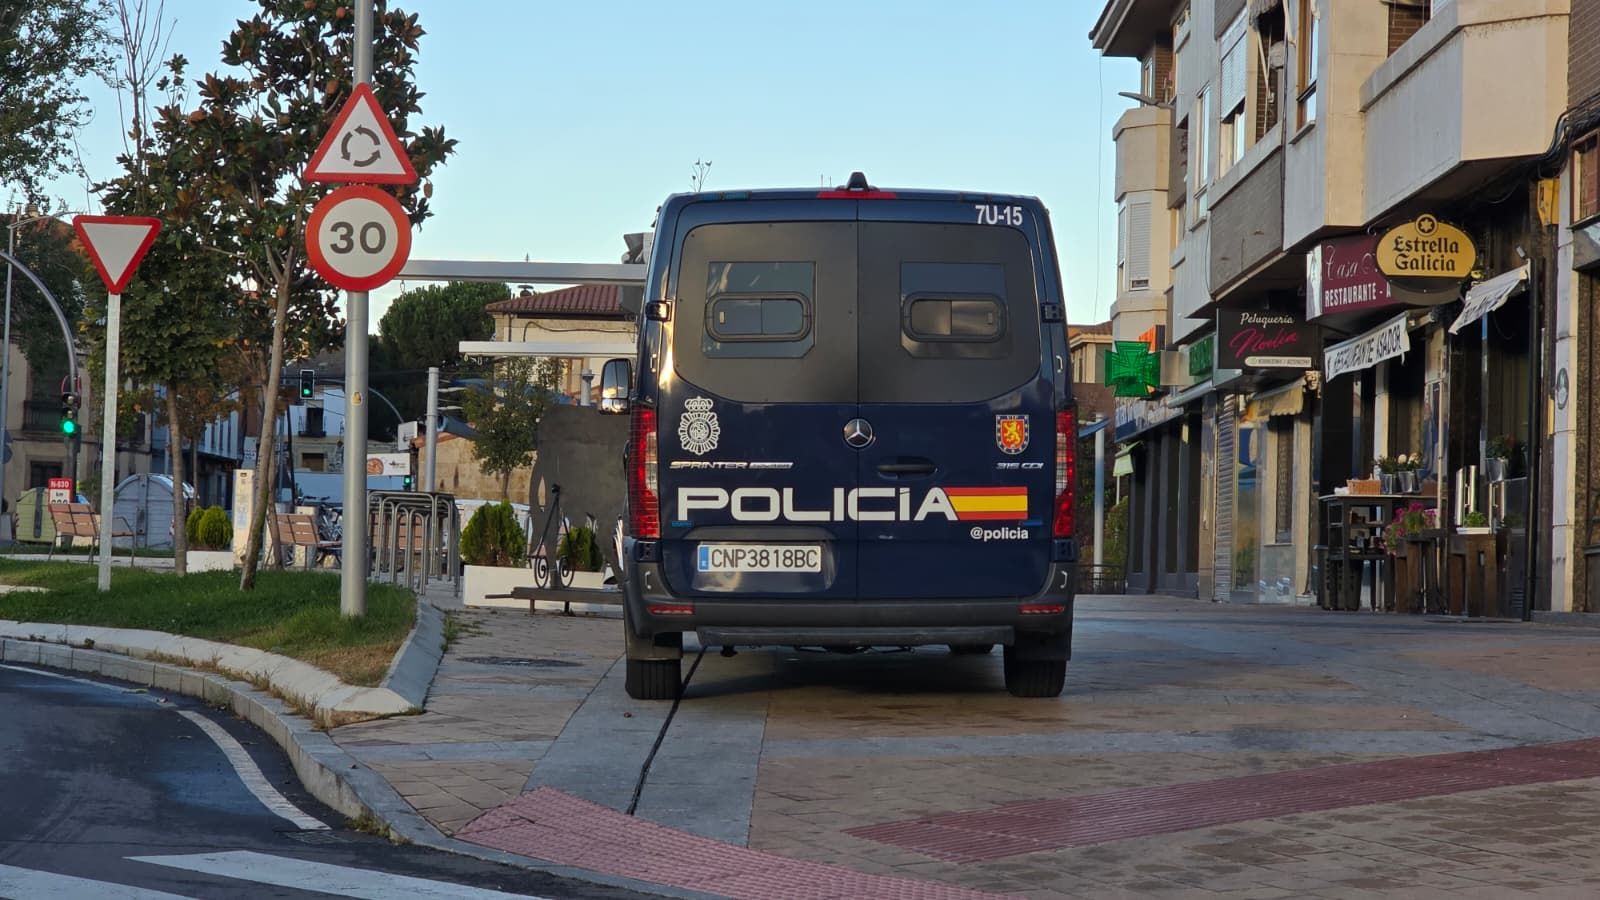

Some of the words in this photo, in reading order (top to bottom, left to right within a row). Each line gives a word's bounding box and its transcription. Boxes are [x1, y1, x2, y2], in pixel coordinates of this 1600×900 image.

[975, 204, 1023, 226] 7U-15
[330, 221, 386, 254] 30
[1393, 236, 1460, 254] Estrella
[1394, 252, 1456, 272] Galicia
[1324, 282, 1377, 308] RESTAURANTE
[669, 461, 748, 470] SPRINTER
[50, 481, 70, 489] N-630
[970, 526, 1029, 542] @policia
[711, 549, 818, 568] CNP3818BC
